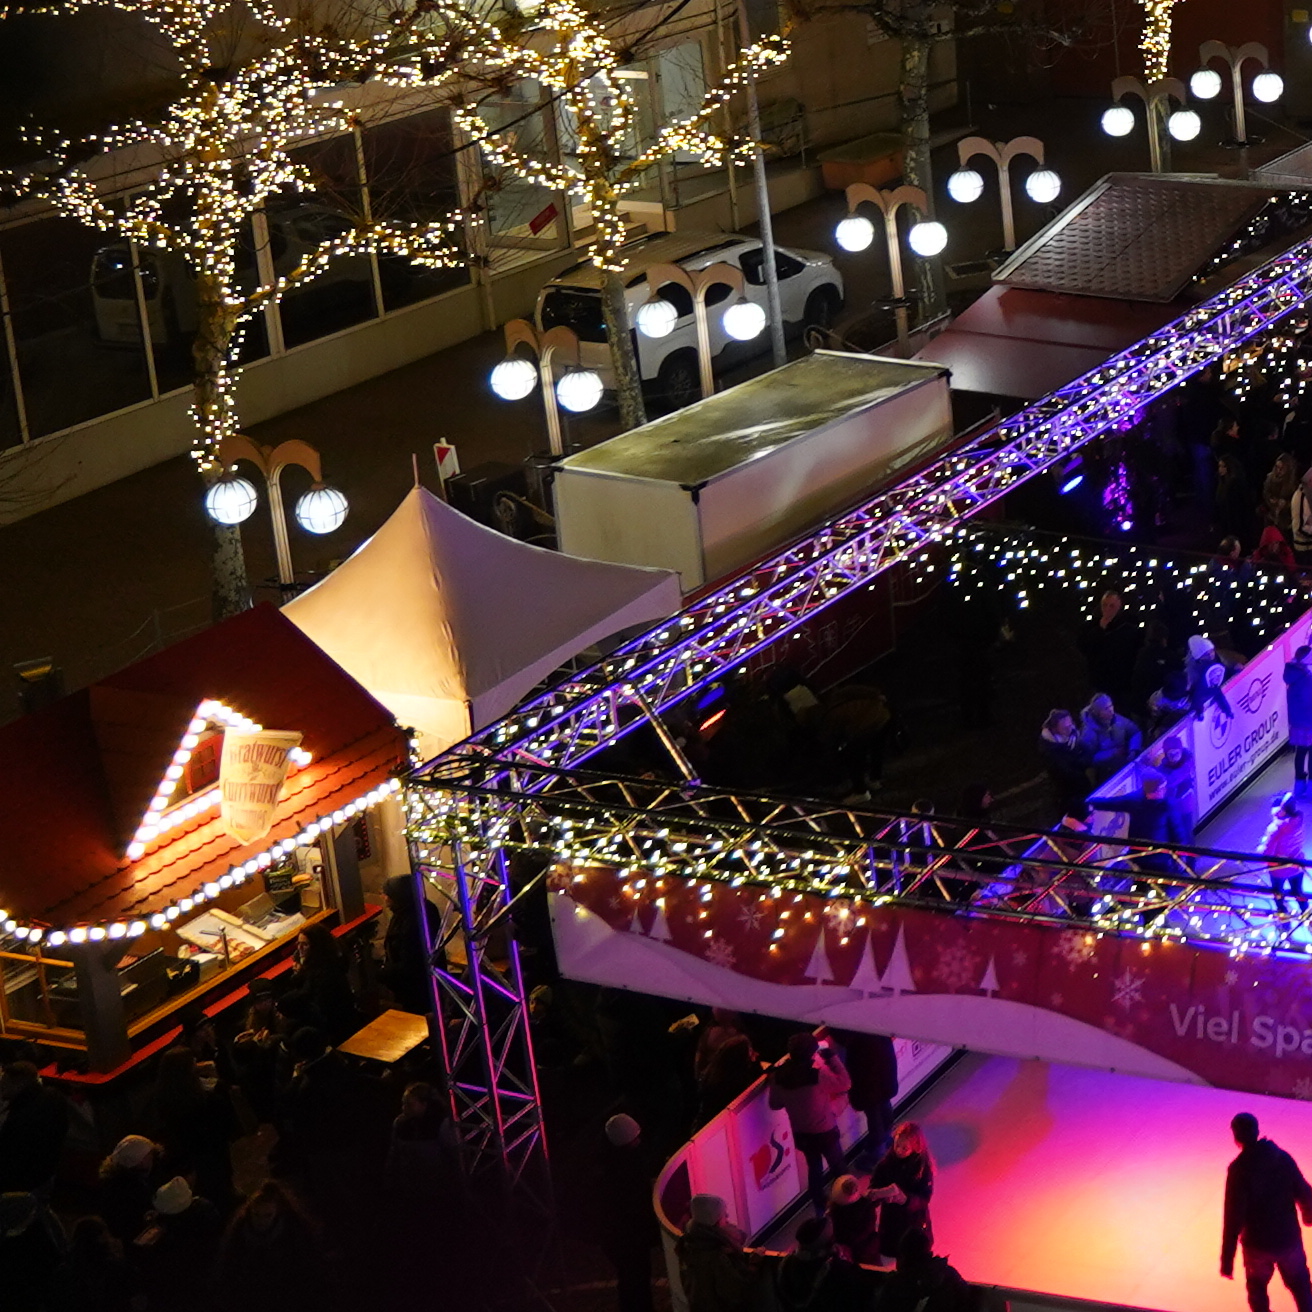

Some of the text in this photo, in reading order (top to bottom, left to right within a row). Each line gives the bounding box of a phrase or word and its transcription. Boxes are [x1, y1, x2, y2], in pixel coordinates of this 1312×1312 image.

[1208, 710, 1279, 787] EULER GROUP
[1169, 1003, 1240, 1044] Viel
